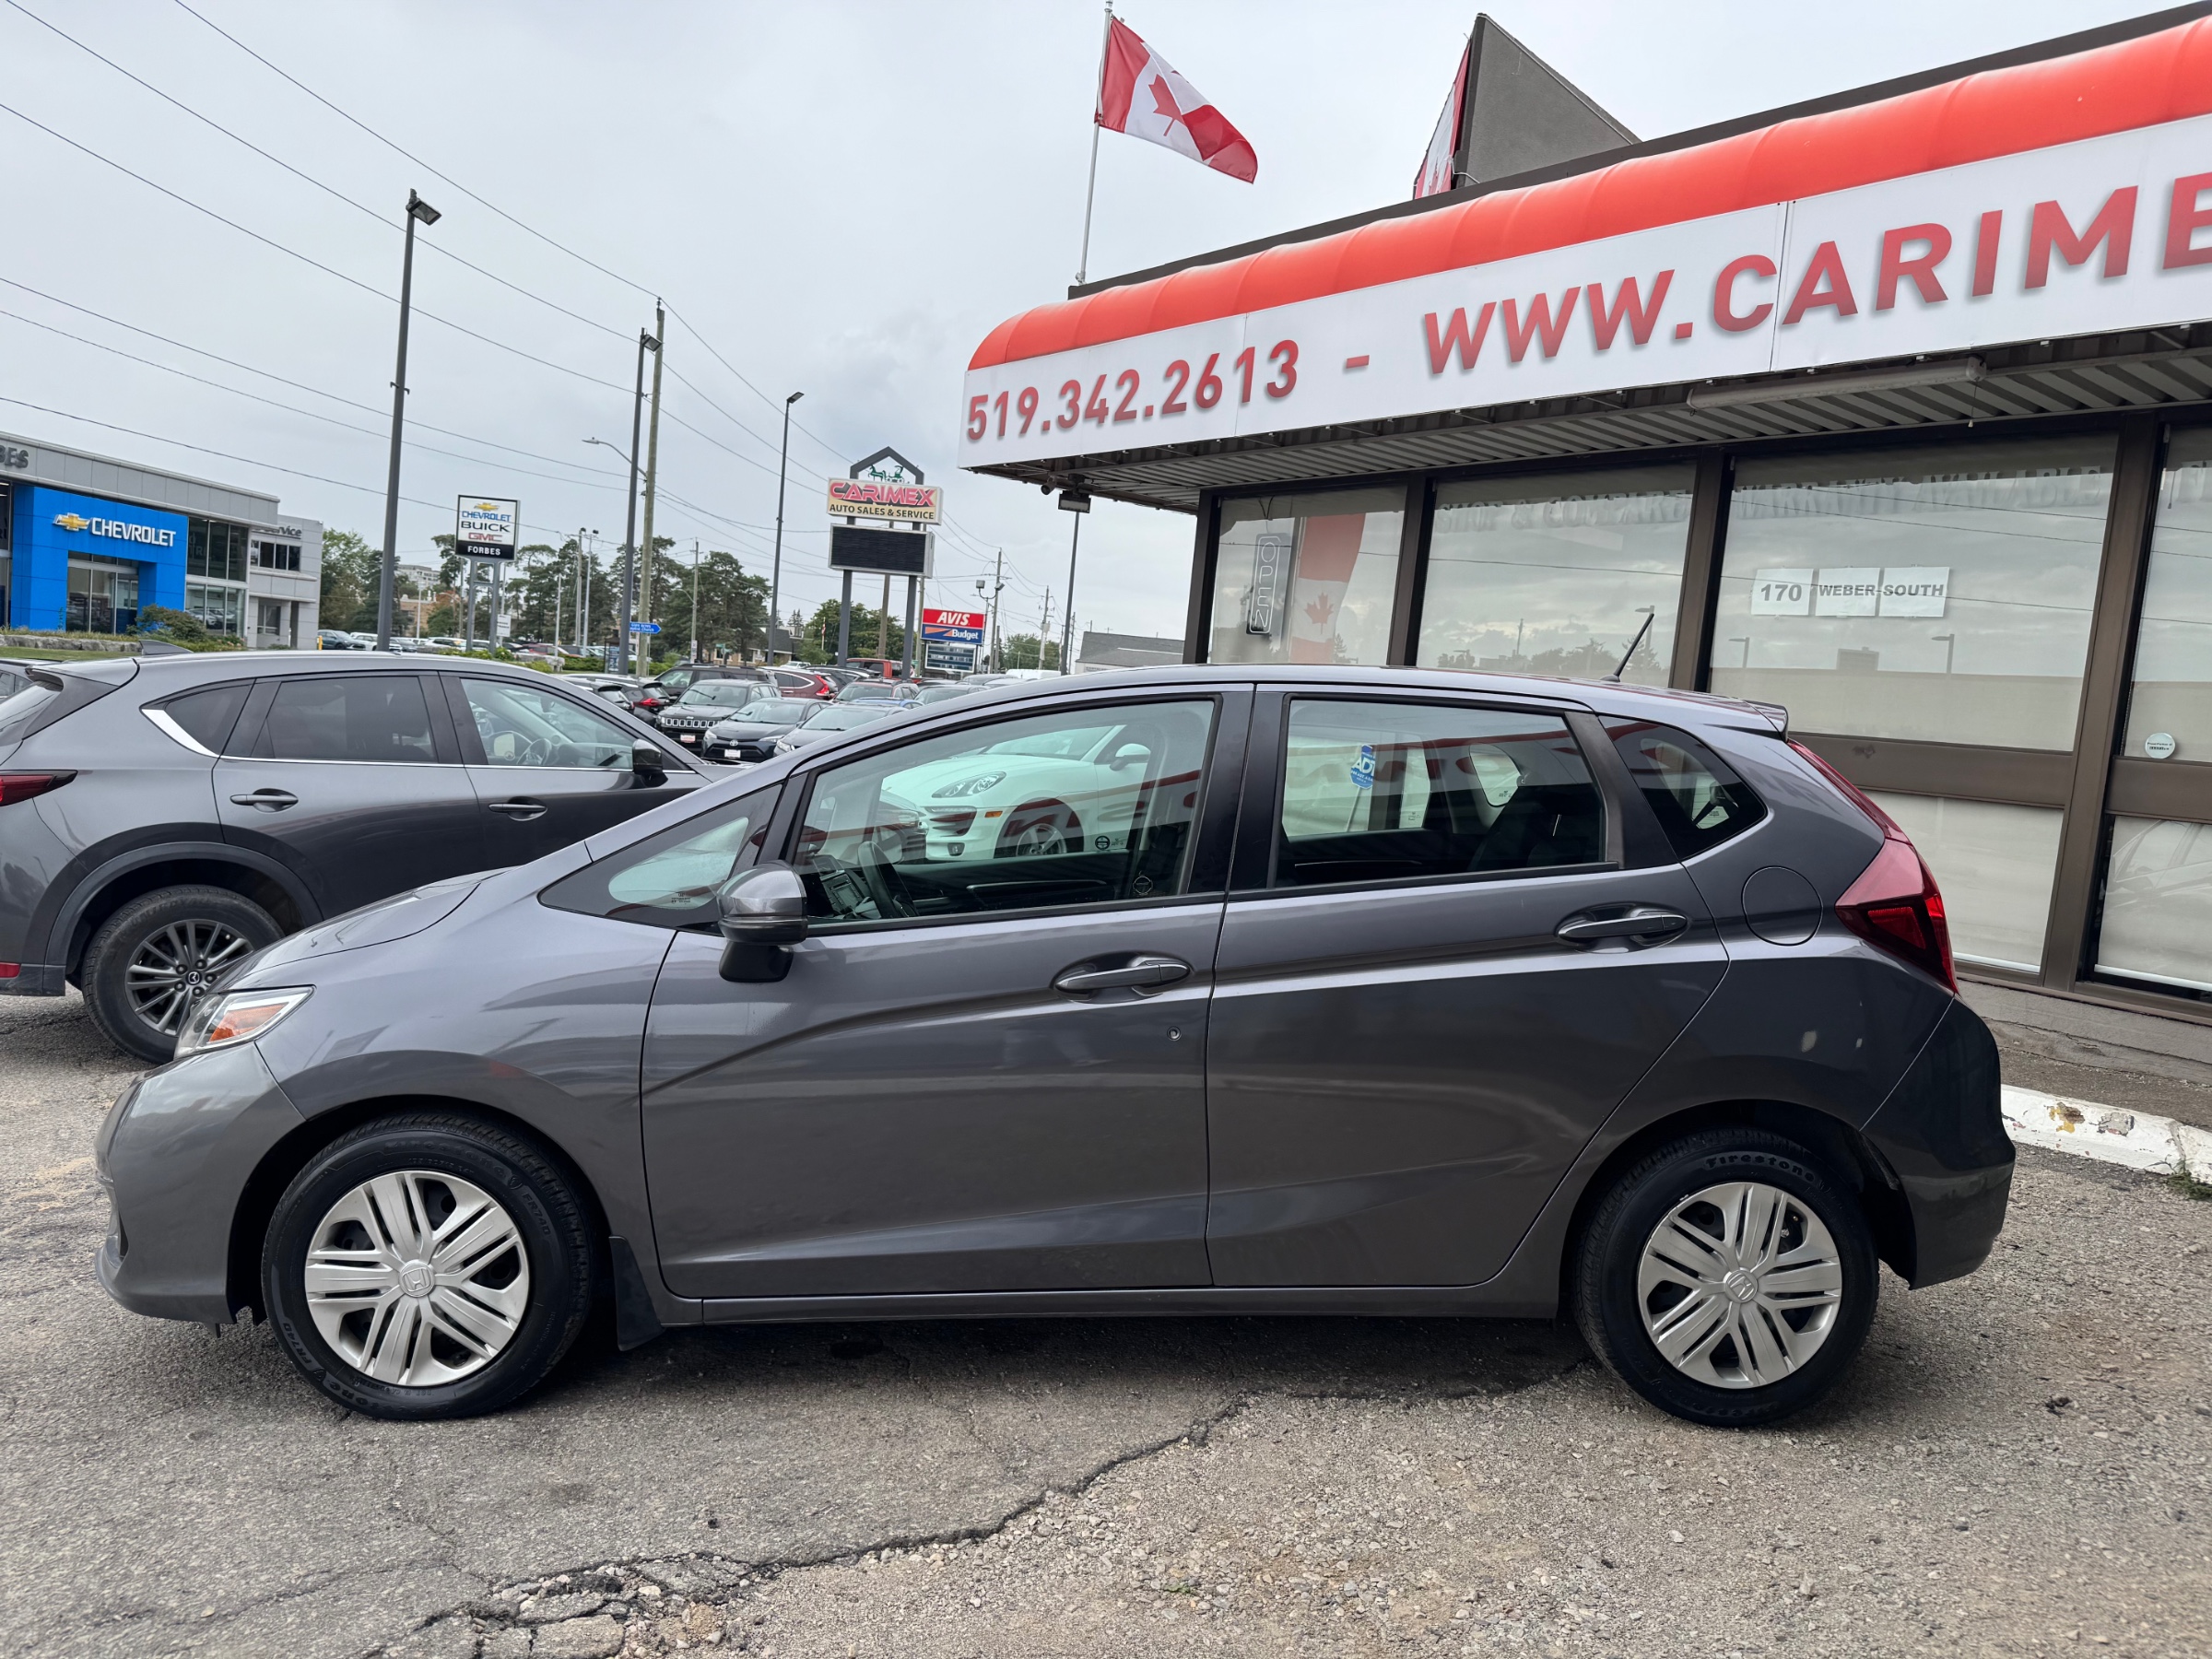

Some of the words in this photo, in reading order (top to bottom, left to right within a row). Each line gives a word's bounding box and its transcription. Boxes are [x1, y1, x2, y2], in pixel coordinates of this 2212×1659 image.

[968, 339, 1300, 441] 519.342.2613
[830, 482, 936, 506] CARIMEX
[462, 511, 512, 522] CHEVROLET
[830, 504, 854, 513] AUTO
[857, 506, 885, 516] SALES
[887, 509, 894, 517] &
[896, 510, 935, 519] SERVICE
[91, 517, 176, 547] CHEVROLET
[461, 521, 511, 533] BUICK
[468, 533, 502, 542] GMC
[467, 546, 501, 556] FORBES
[1254, 542, 1277, 628] OPEN
[1760, 583, 1802, 601] 170
[1819, 584, 1876, 596] WEBER
[1883, 584, 1944, 596] SOUTH
[936, 611, 971, 626] AVIS
[952, 629, 979, 641] Budget
[1706, 1154, 1815, 1182] Firestone
